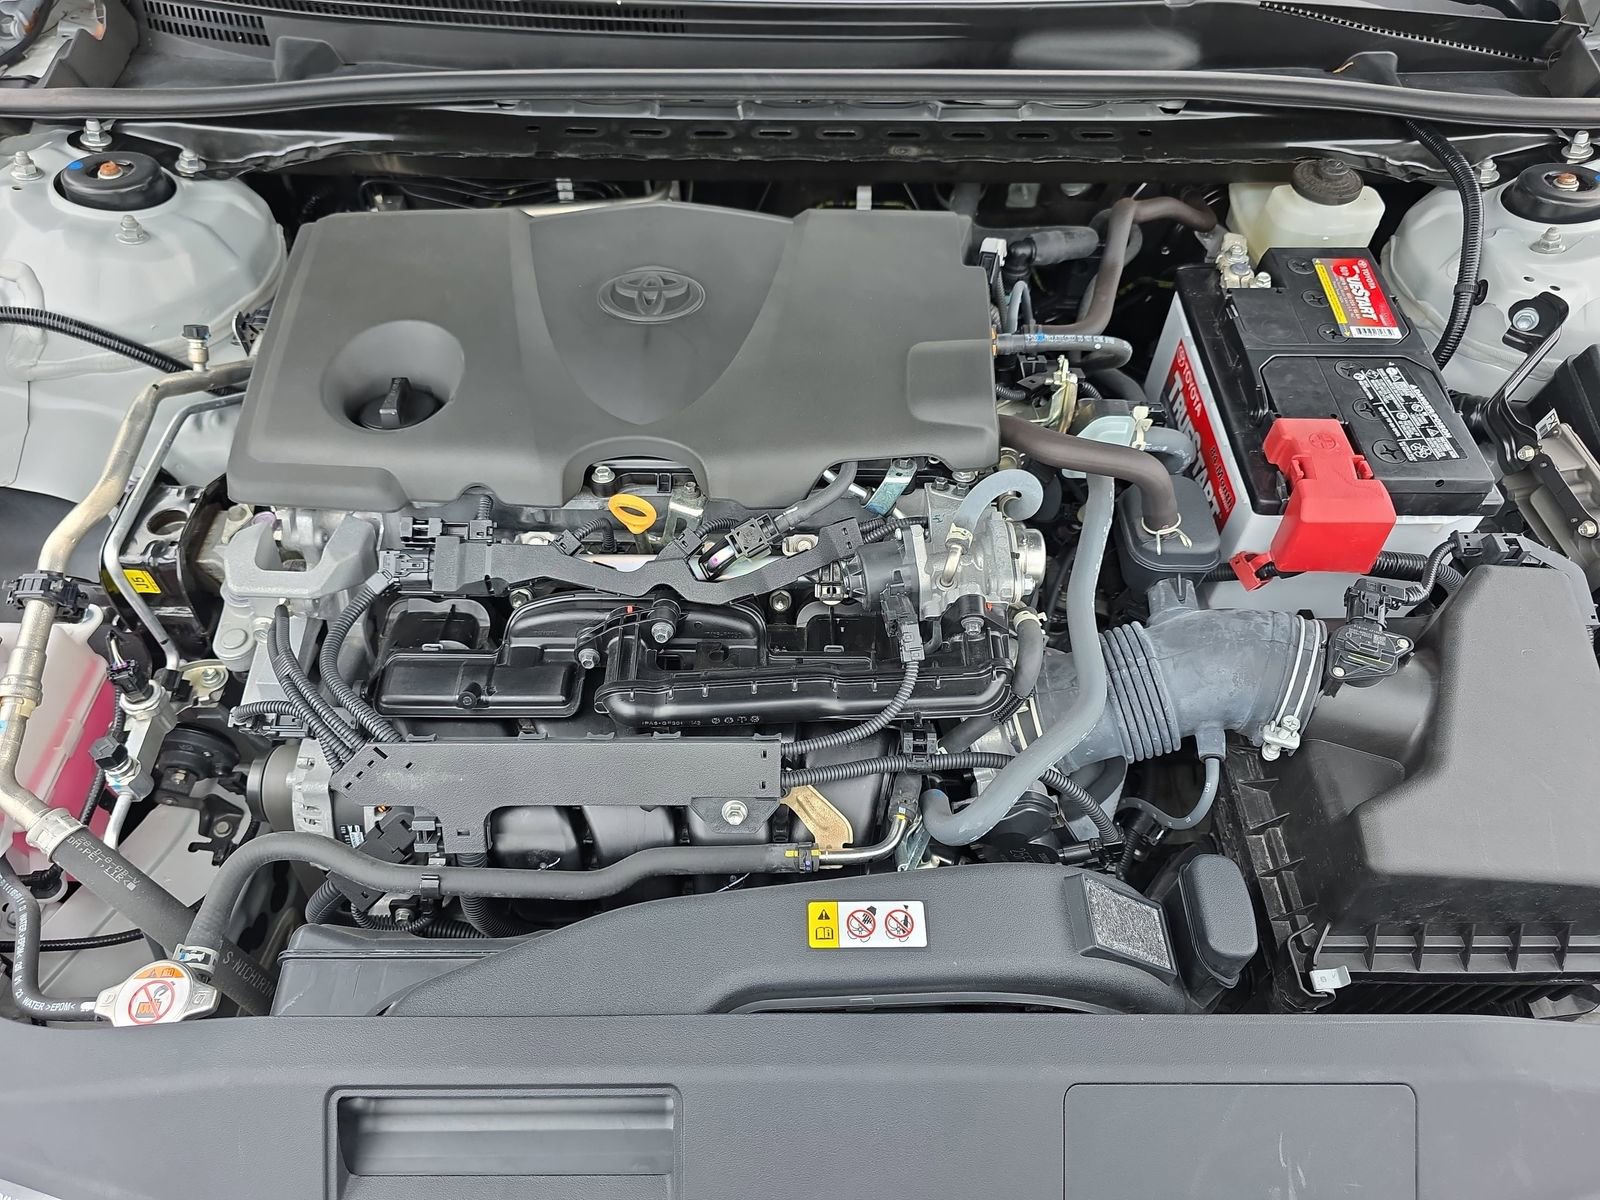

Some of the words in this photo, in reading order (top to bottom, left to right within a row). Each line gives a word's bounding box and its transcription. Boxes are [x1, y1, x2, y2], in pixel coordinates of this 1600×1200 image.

[1361, 269, 1376, 289] TOYOTA
[1183, 362, 1202, 417] TOYOTA
[22, 996, 46, 1011] WATER
[45, 1001, 77, 1012] >EPDM<
